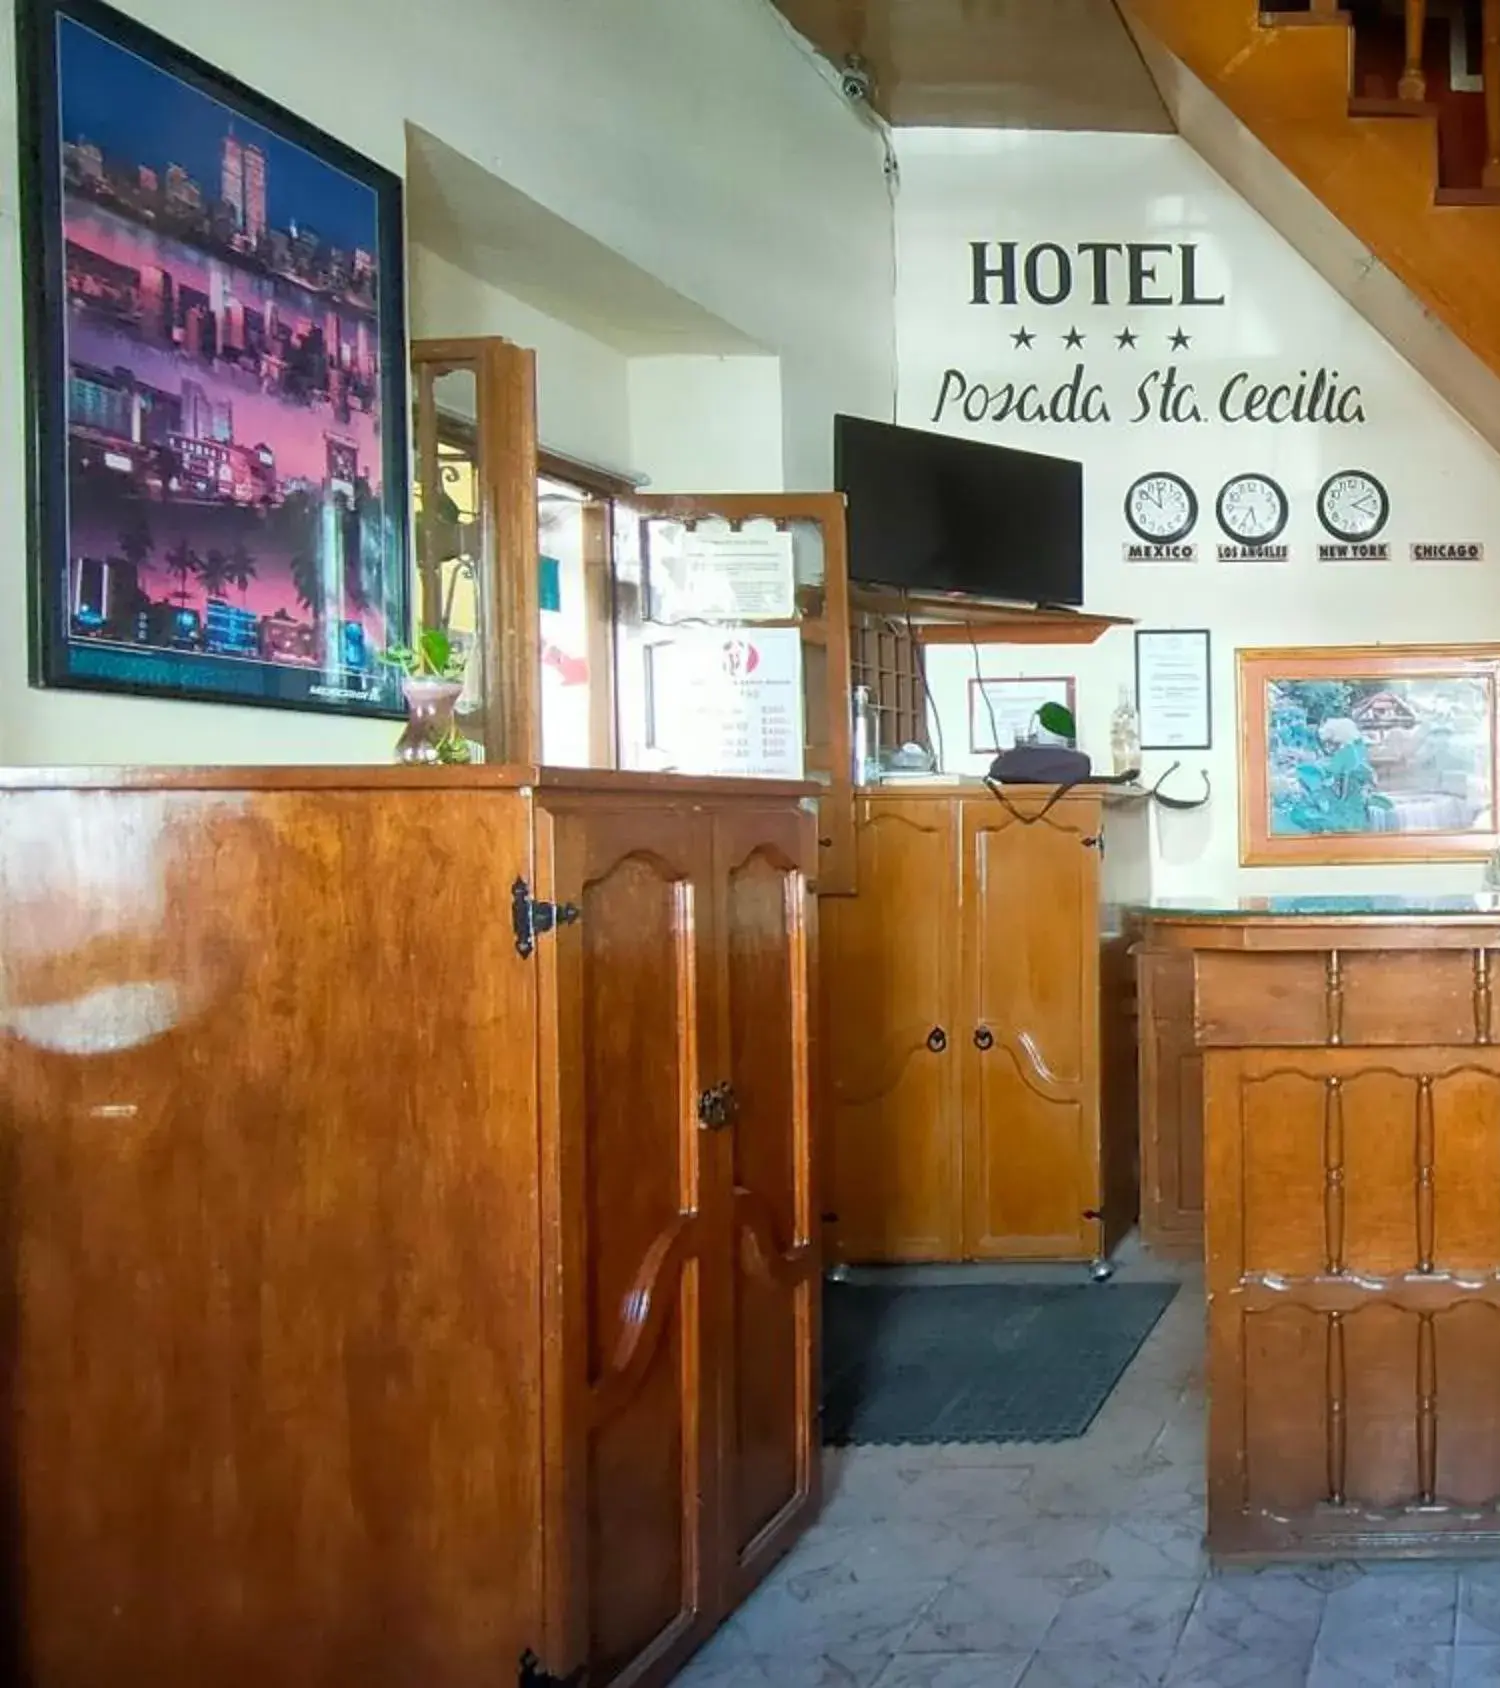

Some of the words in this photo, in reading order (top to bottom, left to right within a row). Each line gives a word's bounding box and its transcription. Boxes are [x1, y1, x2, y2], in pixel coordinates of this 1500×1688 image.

[969, 241, 1225, 306] HOTEL
[931, 363, 1111, 424] Posada
[1219, 367, 1366, 424] Cecilia
[1128, 544, 1193, 558] MEXICO
[1216, 545, 1238, 559] LOS
[1240, 544, 1288, 559] ANGELES
[1319, 544, 1349, 558] NEW
[1351, 543, 1388, 558] YORK
[1414, 544, 1479, 559] CHICAGO
